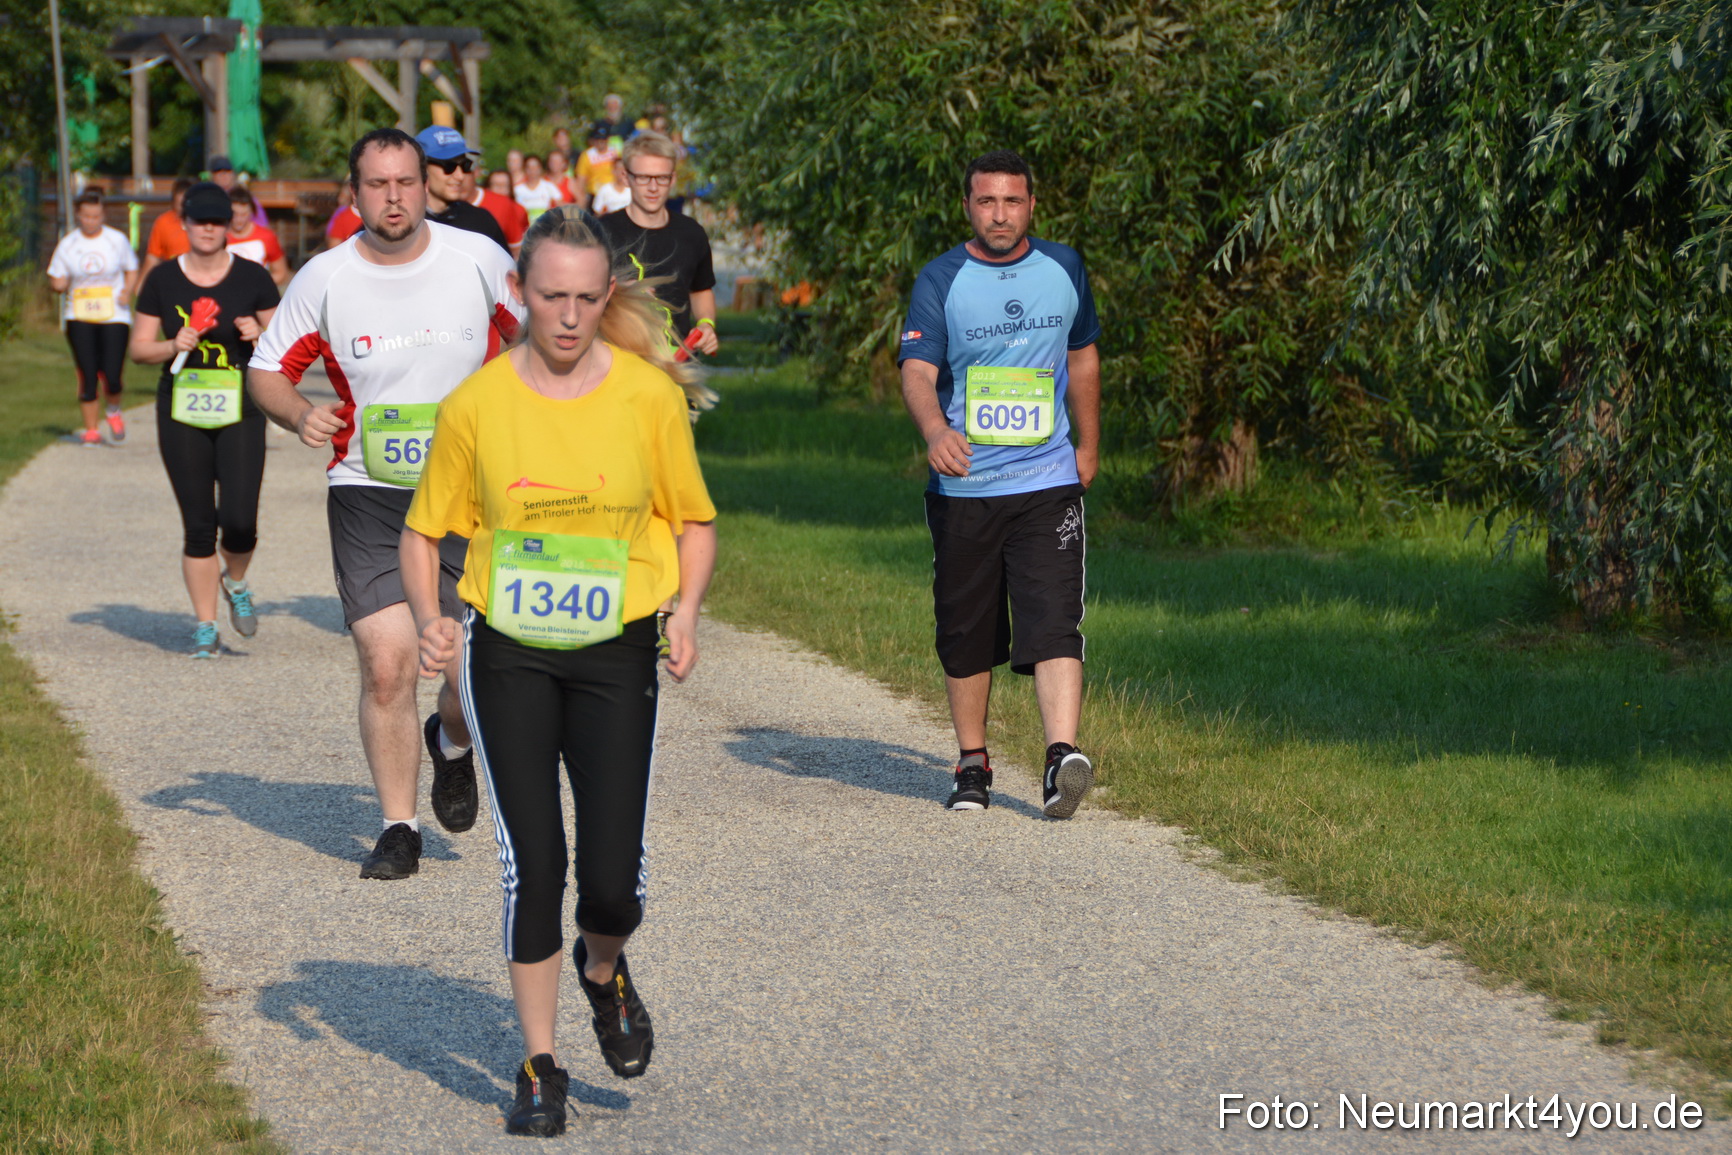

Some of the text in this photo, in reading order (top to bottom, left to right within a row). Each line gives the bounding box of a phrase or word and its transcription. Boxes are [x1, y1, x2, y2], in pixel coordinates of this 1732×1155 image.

[965, 315, 1063, 342] SCHABMÜLLER
[1004, 337, 1028, 348] TEAM
[971, 372, 996, 380] 2013
[186, 393, 226, 412] 232
[976, 404, 1040, 431] 6091
[960, 462, 1061, 482] www.schabmueller.de
[523, 495, 588, 510] Seniorenstift
[524, 513, 540, 521] am
[543, 509, 574, 519] Tiroler
[578, 505, 596, 515] Hof
[513, 549, 560, 562] firmenlauf
[505, 578, 610, 622] 1340
[518, 623, 590, 636] Verena Bleisteiner
